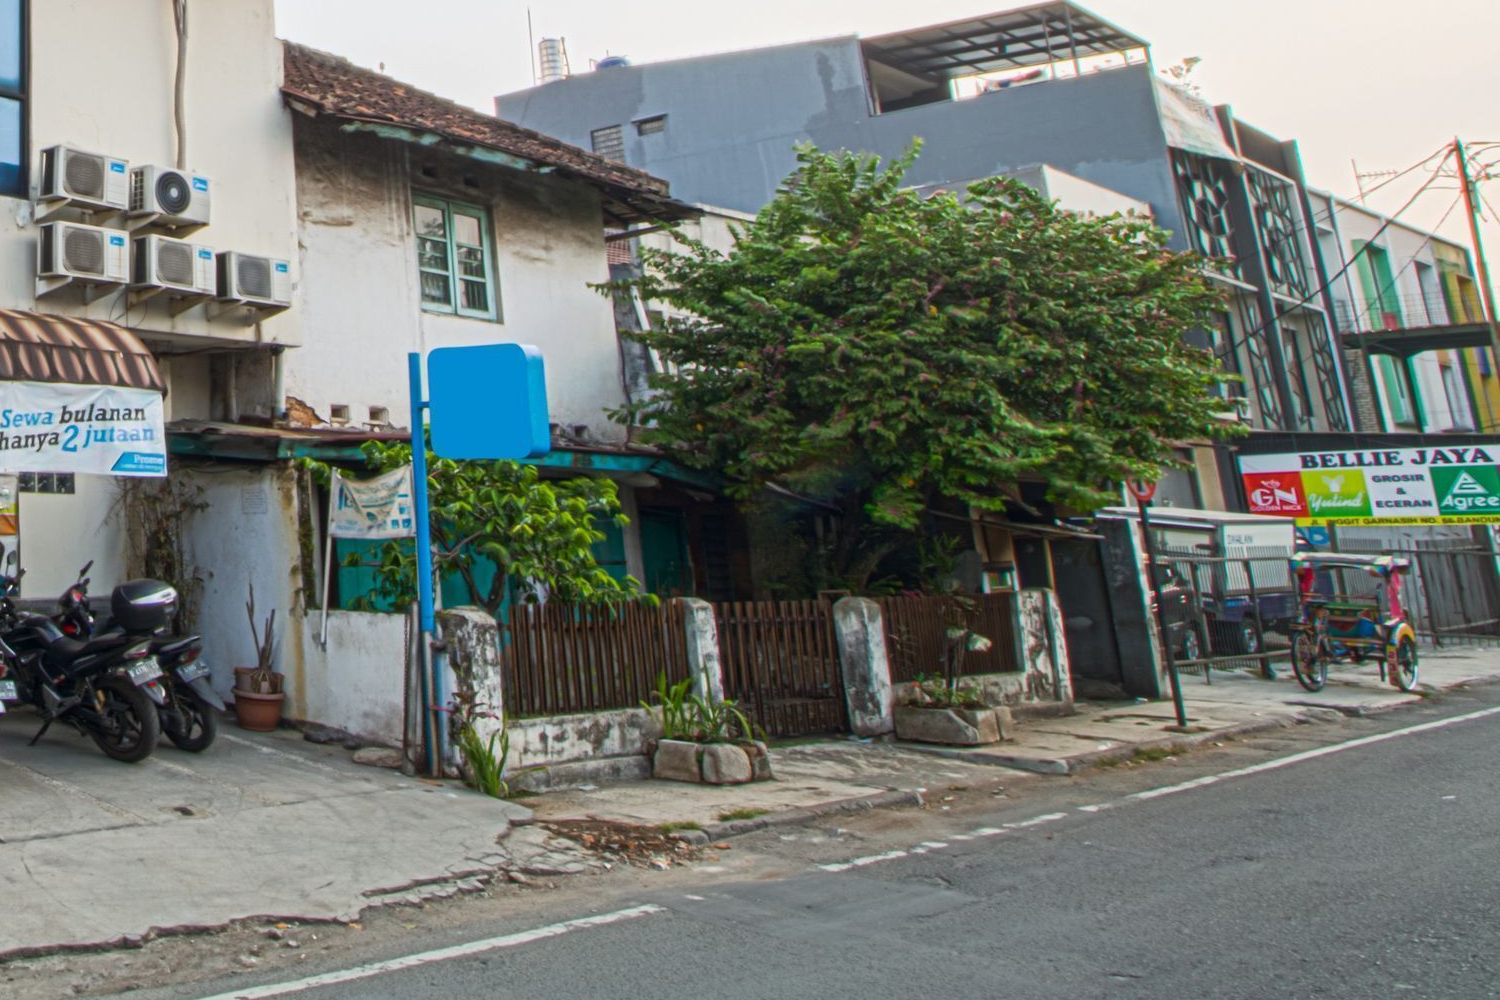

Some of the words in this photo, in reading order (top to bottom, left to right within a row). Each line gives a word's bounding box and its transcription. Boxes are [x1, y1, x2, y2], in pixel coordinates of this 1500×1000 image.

[0, 409, 53, 428] Sewa
[59, 403, 146, 424] bulanan
[61, 424, 80, 452] 2
[82, 424, 155, 448] jutaan
[1299, 451, 1403, 469] BELLIE
[1411, 448, 1495, 465] JAYA
[1371, 473, 1425, 483] GROSIR
[1251, 486, 1299, 506] GN
[1396, 486, 1406, 495] &
[1375, 499, 1432, 508] ECERAN
[1440, 494, 1500, 511] Agree
[1363, 517, 1417, 525] GARNASIH
